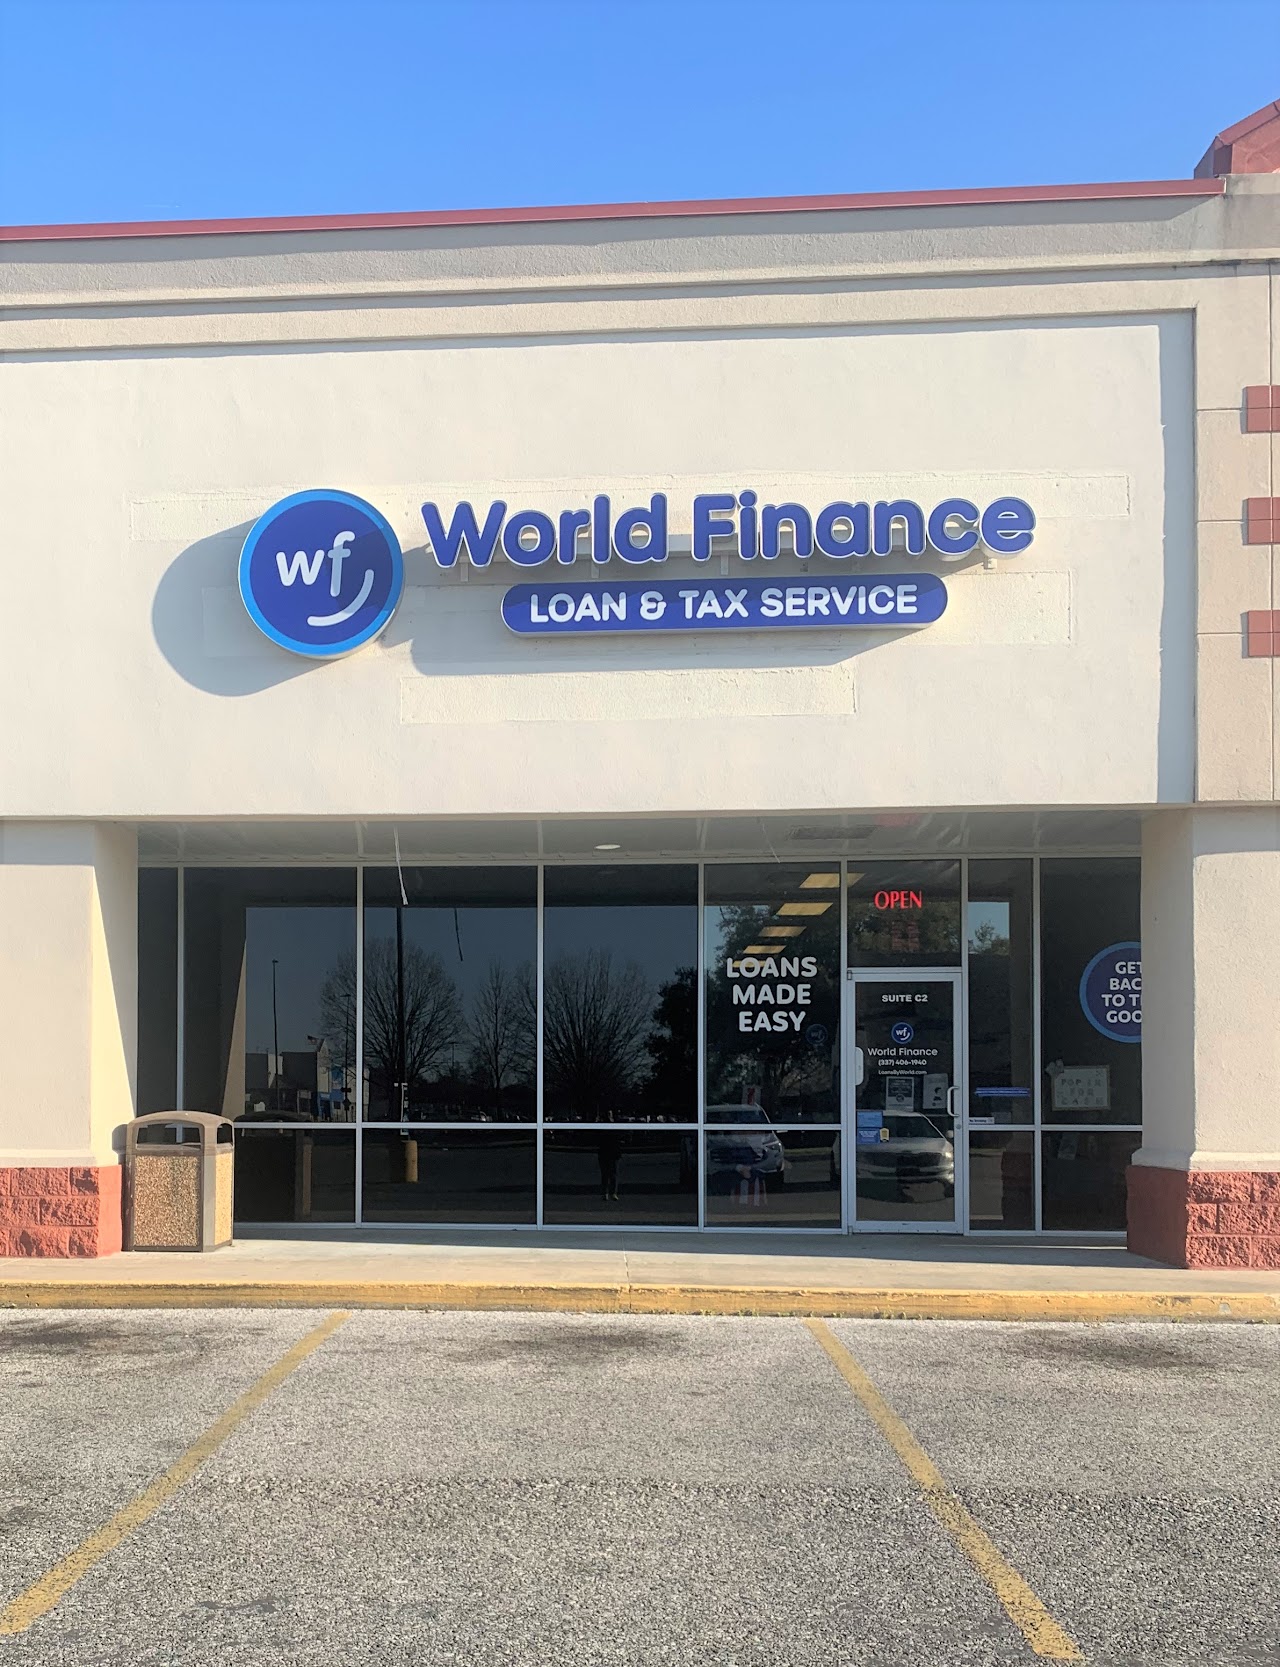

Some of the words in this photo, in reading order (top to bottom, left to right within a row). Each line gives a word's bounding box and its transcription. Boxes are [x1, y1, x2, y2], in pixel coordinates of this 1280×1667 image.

[420, 492, 669, 570] World
[691, 489, 1037, 563] Finance
[275, 530, 356, 598] wf
[530, 591, 628, 623] LOAN
[639, 590, 667, 621] &
[678, 588, 750, 620] TAX
[760, 583, 919, 617] SERVICE
[874, 889, 923, 911] OPEN
[726, 956, 818, 978] LOANS
[732, 983, 812, 1005] MADE
[1109, 977, 1142, 991] BAC
[881, 994, 913, 1003] SUITE
[914, 994, 929, 1002] C2
[1101, 993, 1126, 1007] TO
[738, 1011, 806, 1032] EASY
[1106, 1010, 1142, 1023] GOO
[867, 1047, 897, 1056] World
[898, 1047, 938, 1056] Finance
[878, 1059, 894, 1067] (337)
